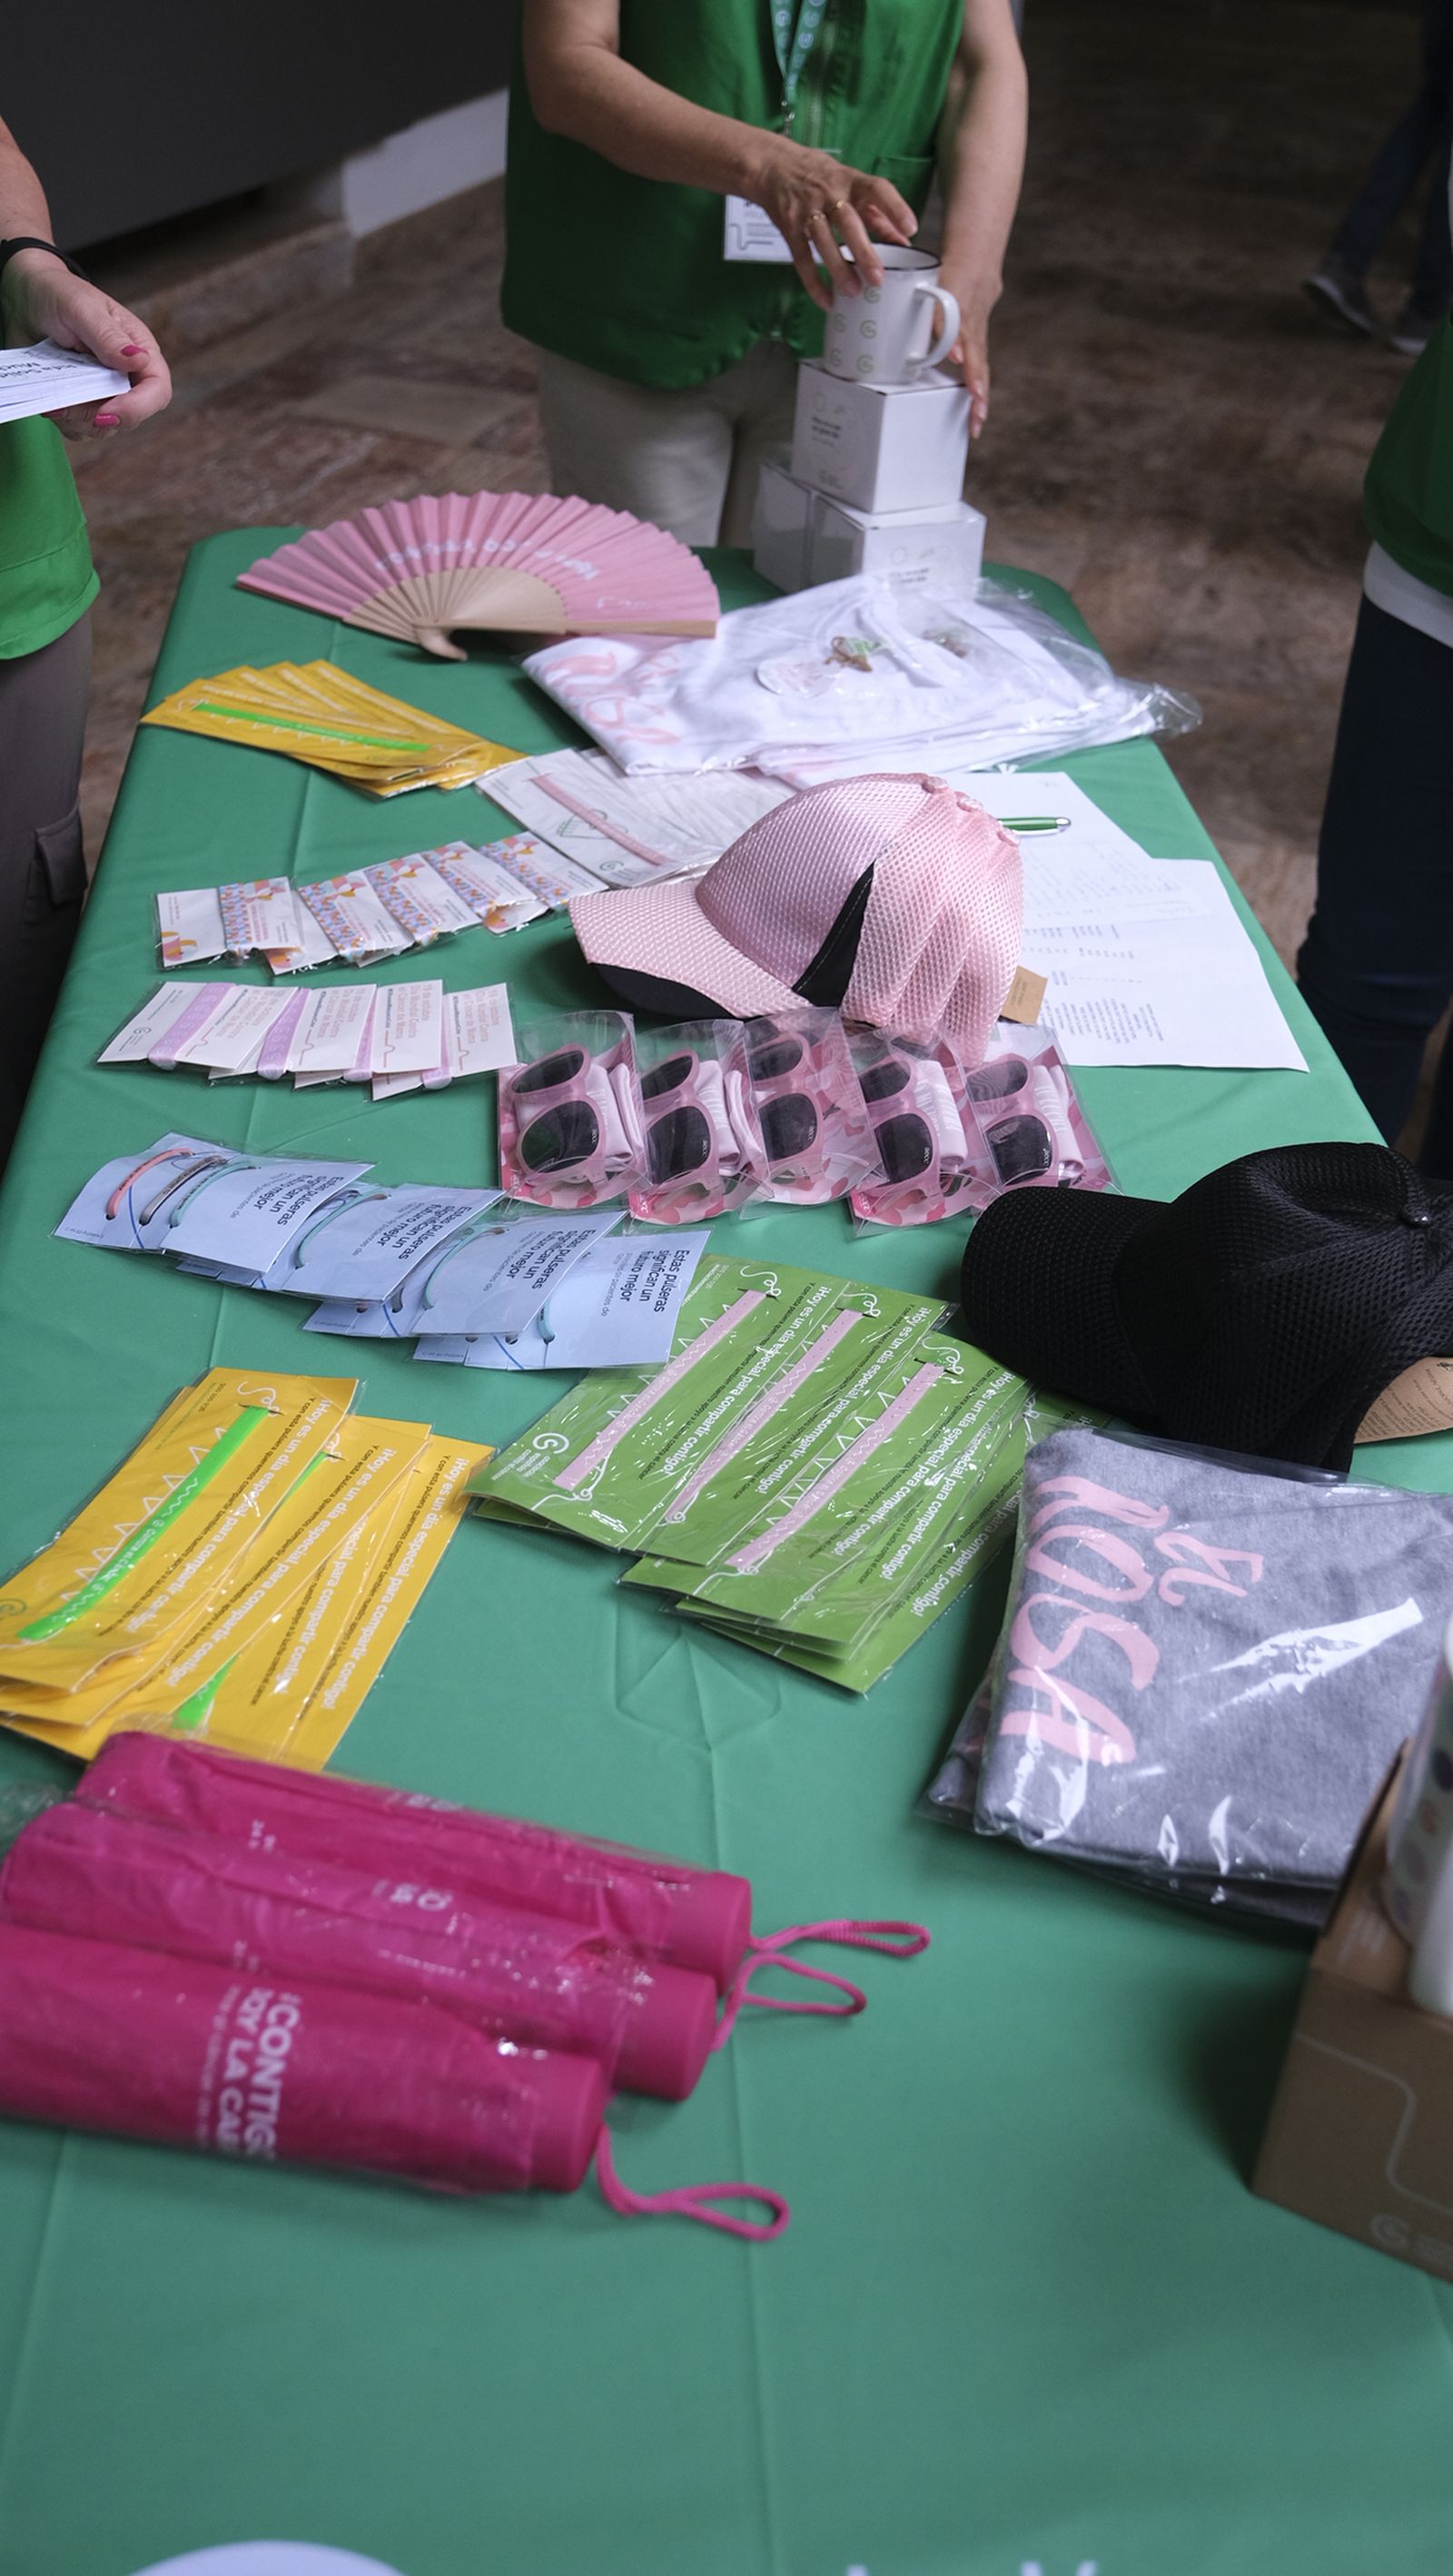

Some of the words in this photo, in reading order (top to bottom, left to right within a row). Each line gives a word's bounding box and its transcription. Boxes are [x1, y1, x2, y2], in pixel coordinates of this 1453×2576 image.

[316, 1176, 344, 1191] Estas
[253, 1186, 282, 1209] mejor
[269, 1199, 284, 1213] un
[277, 1189, 317, 1225] pulseras
[440, 1205, 472, 1224] Estas
[377, 1222, 409, 1246] mejor
[391, 1236, 409, 1249] un
[398, 1224, 442, 1259] pulseras
[566, 1229, 596, 1248] Estas
[506, 1250, 534, 1278] mejor
[522, 1265, 537, 1279] un
[531, 1249, 570, 1288] pulseras
[645, 1249, 669, 1287] significan
[668, 1249, 689, 1272] Estas
[619, 1273, 638, 1301] mejor
[638, 1288, 652, 1302] un
[653, 1273, 677, 1312] pulseras
[789, 1317, 804, 1329] un
[799, 1306, 813, 1317] es
[888, 1337, 903, 1349] un
[898, 1326, 913, 1337] es
[729, 1375, 753, 1396] para
[845, 1364, 881, 1398] especial
[982, 1388, 996, 1399] es
[288, 1413, 301, 1427] esta
[298, 1401, 311, 1414] con
[694, 1395, 735, 1436] compartir
[828, 1397, 849, 1418] para
[970, 1398, 986, 1416] un
[271, 1426, 292, 1450] pulsera
[296, 1424, 311, 1437] es
[284, 1437, 301, 1453] un
[361, 1448, 373, 1461] con
[662, 1436, 697, 1476] contigo!
[924, 1427, 962, 1467] especial
[246, 1450, 273, 1480] queremos
[349, 1460, 363, 1475] esta
[428, 1471, 440, 1485] esta
[436, 1459, 446, 1472] con
[757, 1458, 793, 1494] contigo!
[905, 1464, 930, 1486] para
[329, 1474, 352, 1497] pulsera
[356, 1472, 372, 1485] es
[439, 1481, 452, 1495] es
[935, 1476, 955, 1500] para
[222, 1480, 249, 1510] compartir
[342, 1486, 360, 1501] un
[416, 1485, 432, 1509] pulsera
[432, 1496, 444, 1511] un
[867, 1485, 910, 1524] compartir
[301, 1497, 331, 1527] queremos
[399, 1509, 420, 1540] queremos
[907, 1500, 941, 1544] compartir
[983, 1507, 1007, 1533] para
[212, 1515, 238, 1542] para
[275, 1526, 304, 1555] compartir
[285, 1519, 330, 1564] especial
[834, 1523, 870, 1555] contigo!
[382, 1540, 403, 1570] compartir
[395, 1531, 427, 1576] especial
[881, 1543, 911, 1580] contigo!
[944, 1533, 984, 1580] compartir
[167, 1543, 215, 1594] compartir
[262, 1563, 289, 1588] para
[326, 1560, 346, 1586] para
[381, 1576, 402, 1603] para
[911, 1574, 949, 1616] contigo!
[212, 1589, 264, 1642] compartir
[300, 1588, 333, 1643] compartir
[351, 1604, 387, 1660] compartir
[166, 1641, 213, 1686] contigo!
[322, 1661, 355, 1708] contigo!
[224, 2038, 255, 2081] LA
